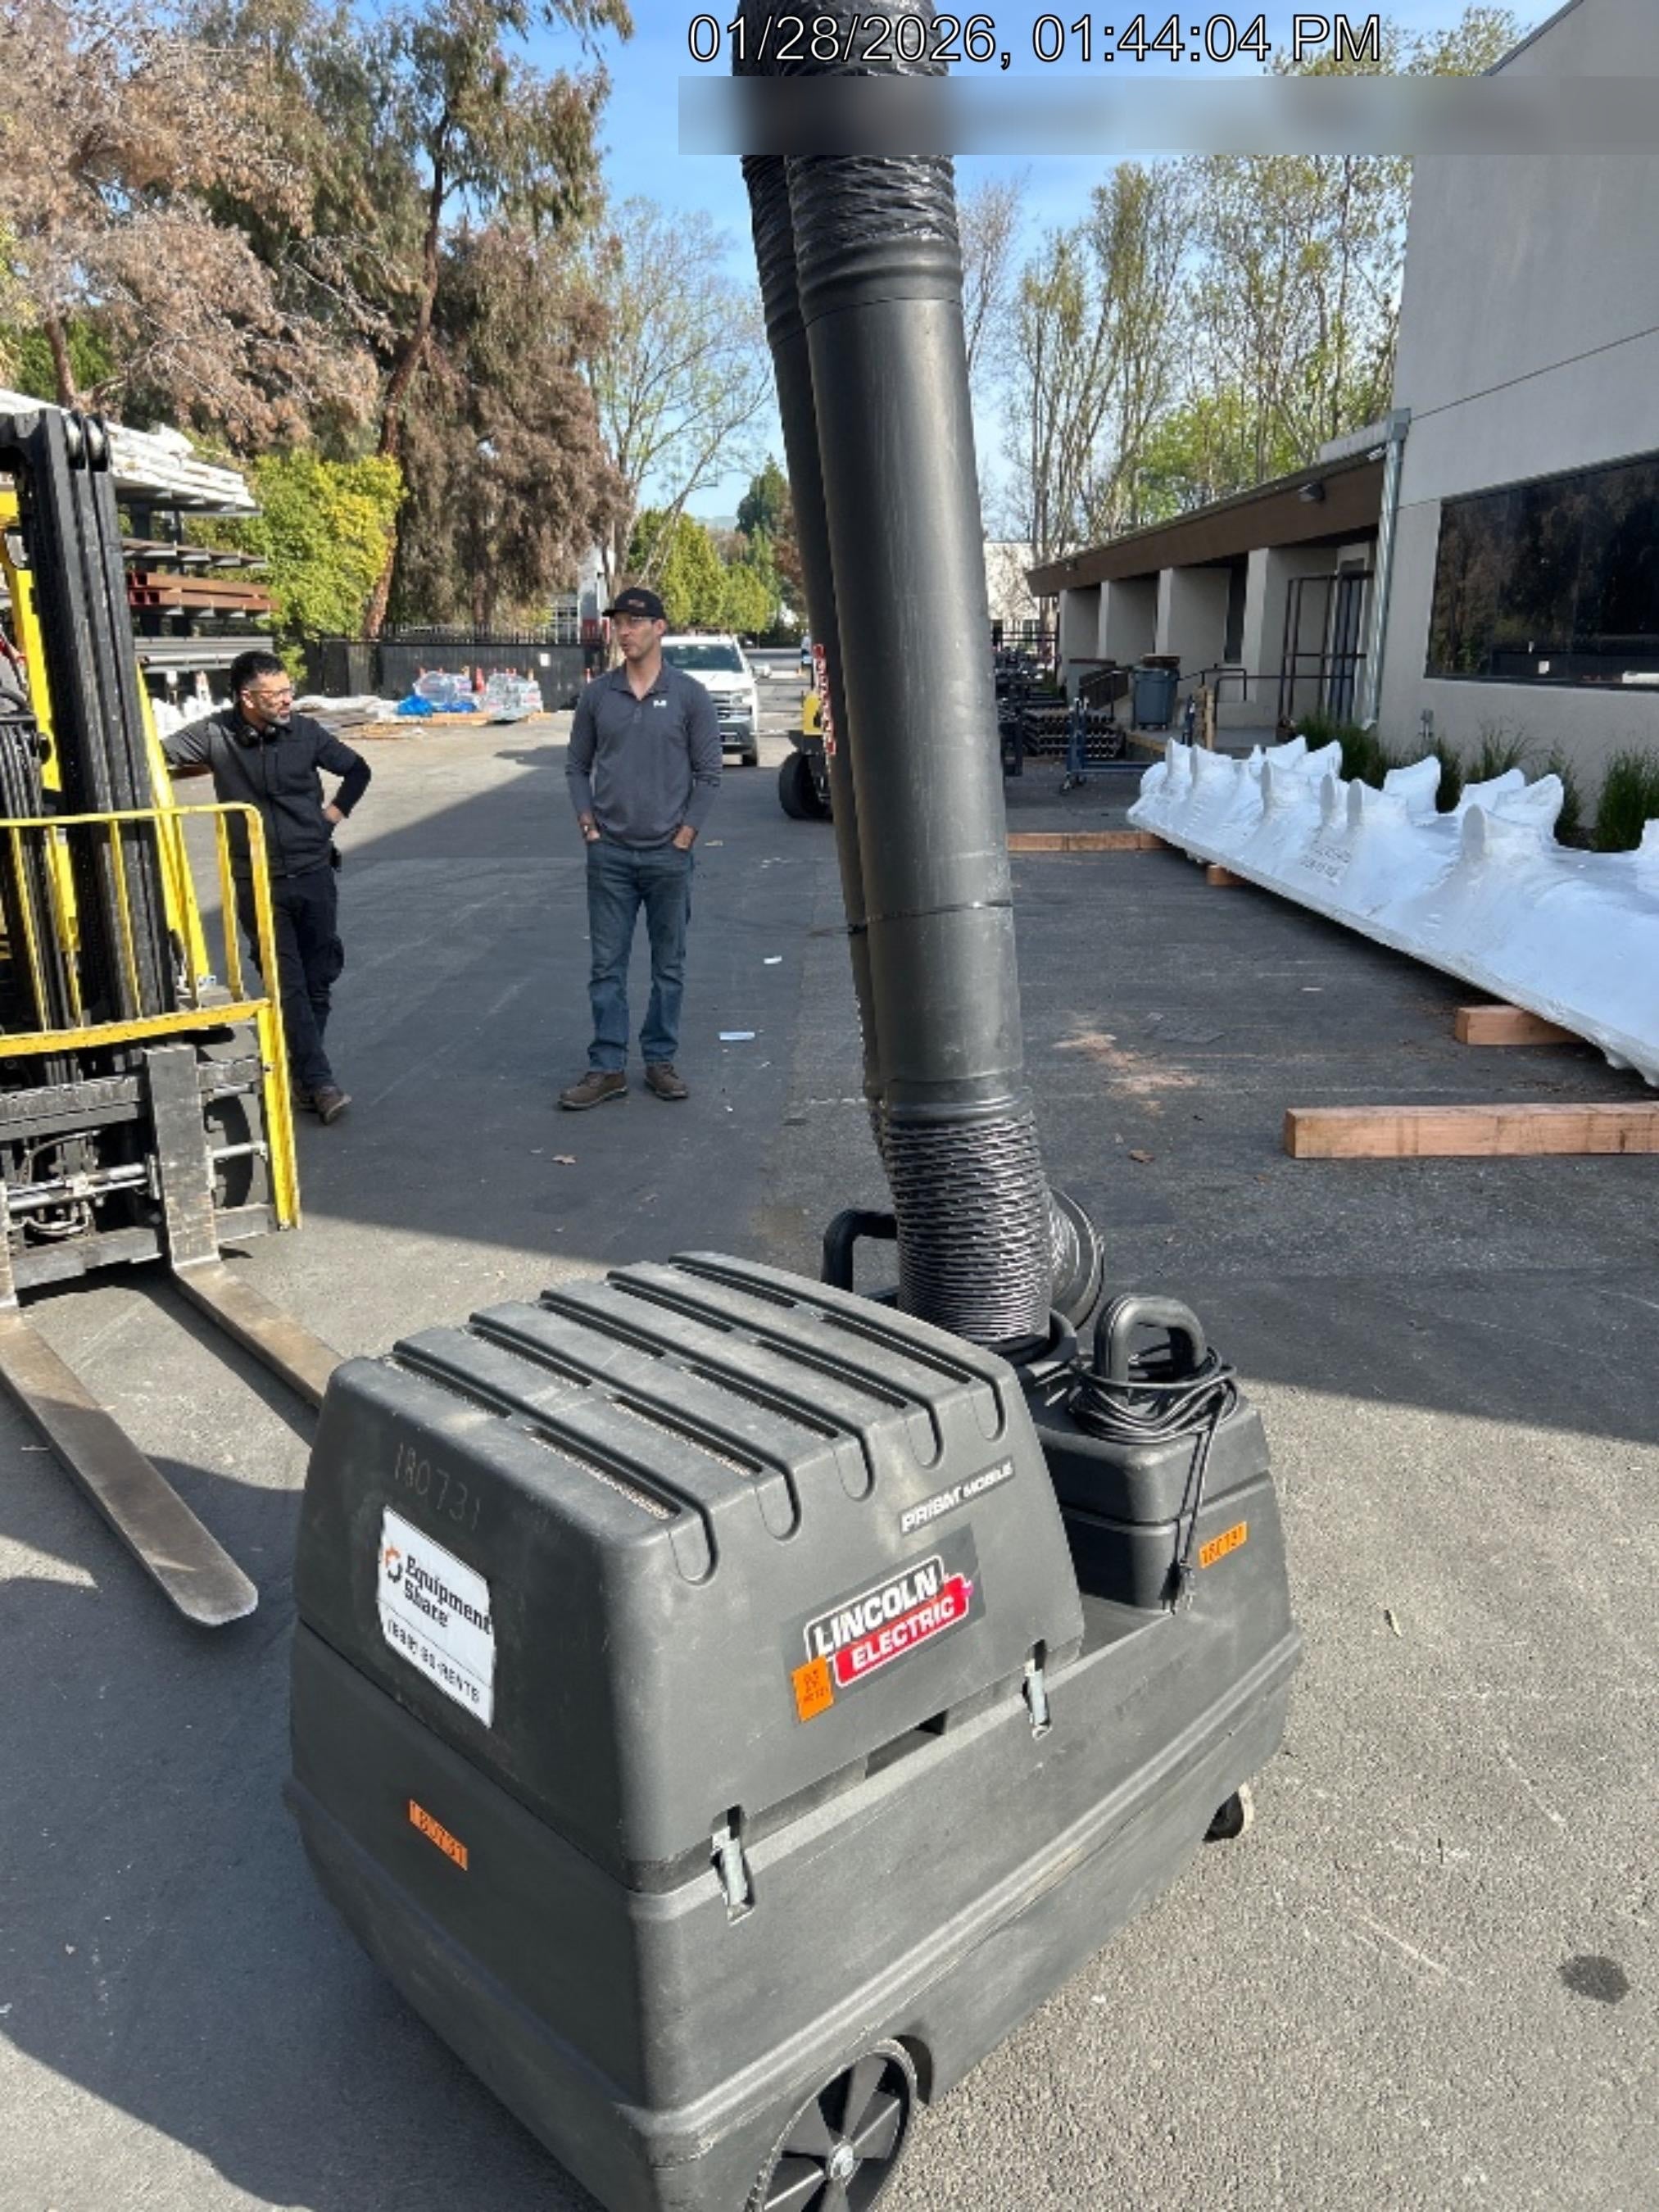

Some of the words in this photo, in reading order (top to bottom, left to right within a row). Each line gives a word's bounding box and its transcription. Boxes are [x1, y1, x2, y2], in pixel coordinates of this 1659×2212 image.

[404, 1578, 449, 1629] Share
[405, 1554, 492, 1636] Equipment
[814, 1565, 939, 1656] LINCOLN
[850, 1596, 955, 1670] ELECTRIC
